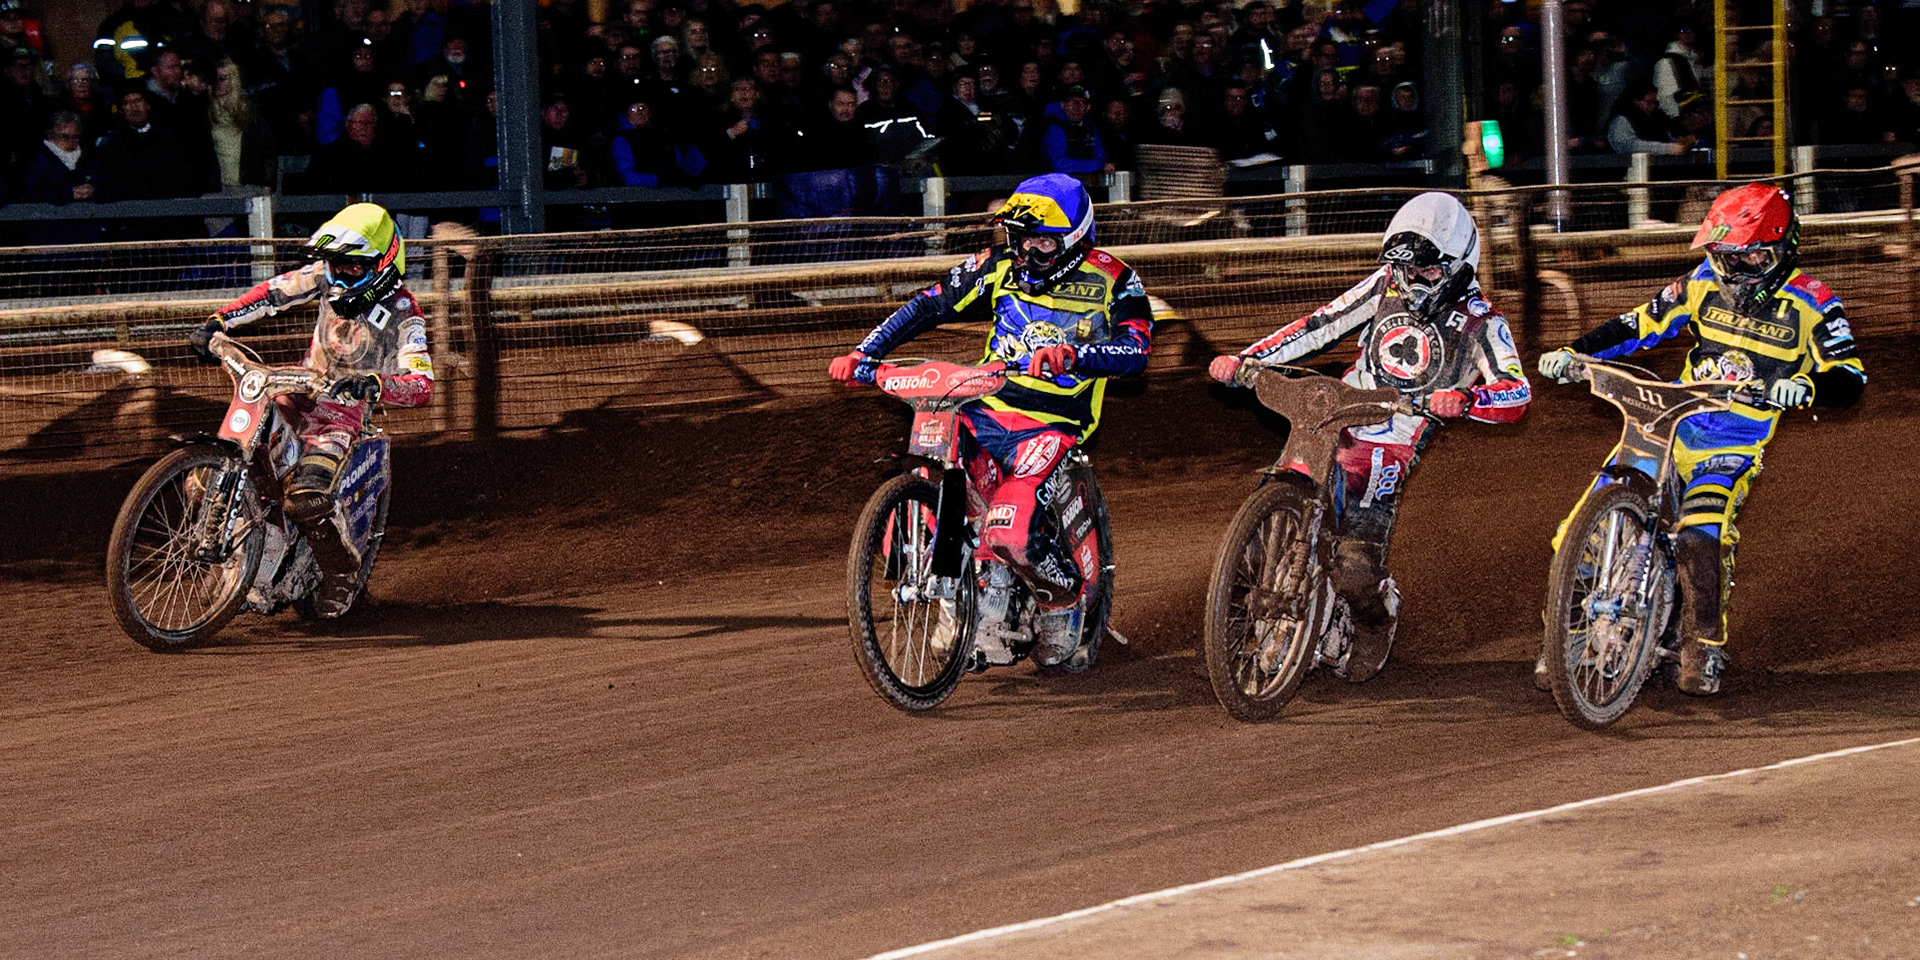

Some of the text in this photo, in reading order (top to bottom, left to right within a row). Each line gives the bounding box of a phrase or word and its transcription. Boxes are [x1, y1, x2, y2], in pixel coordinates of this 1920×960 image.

[1049, 253, 1083, 281] TEXOM
[375, 309, 386, 324] 1
[1077, 319, 1092, 338] 5
[1380, 317, 1410, 334] BELLE
[884, 376, 927, 391] ROBSON
